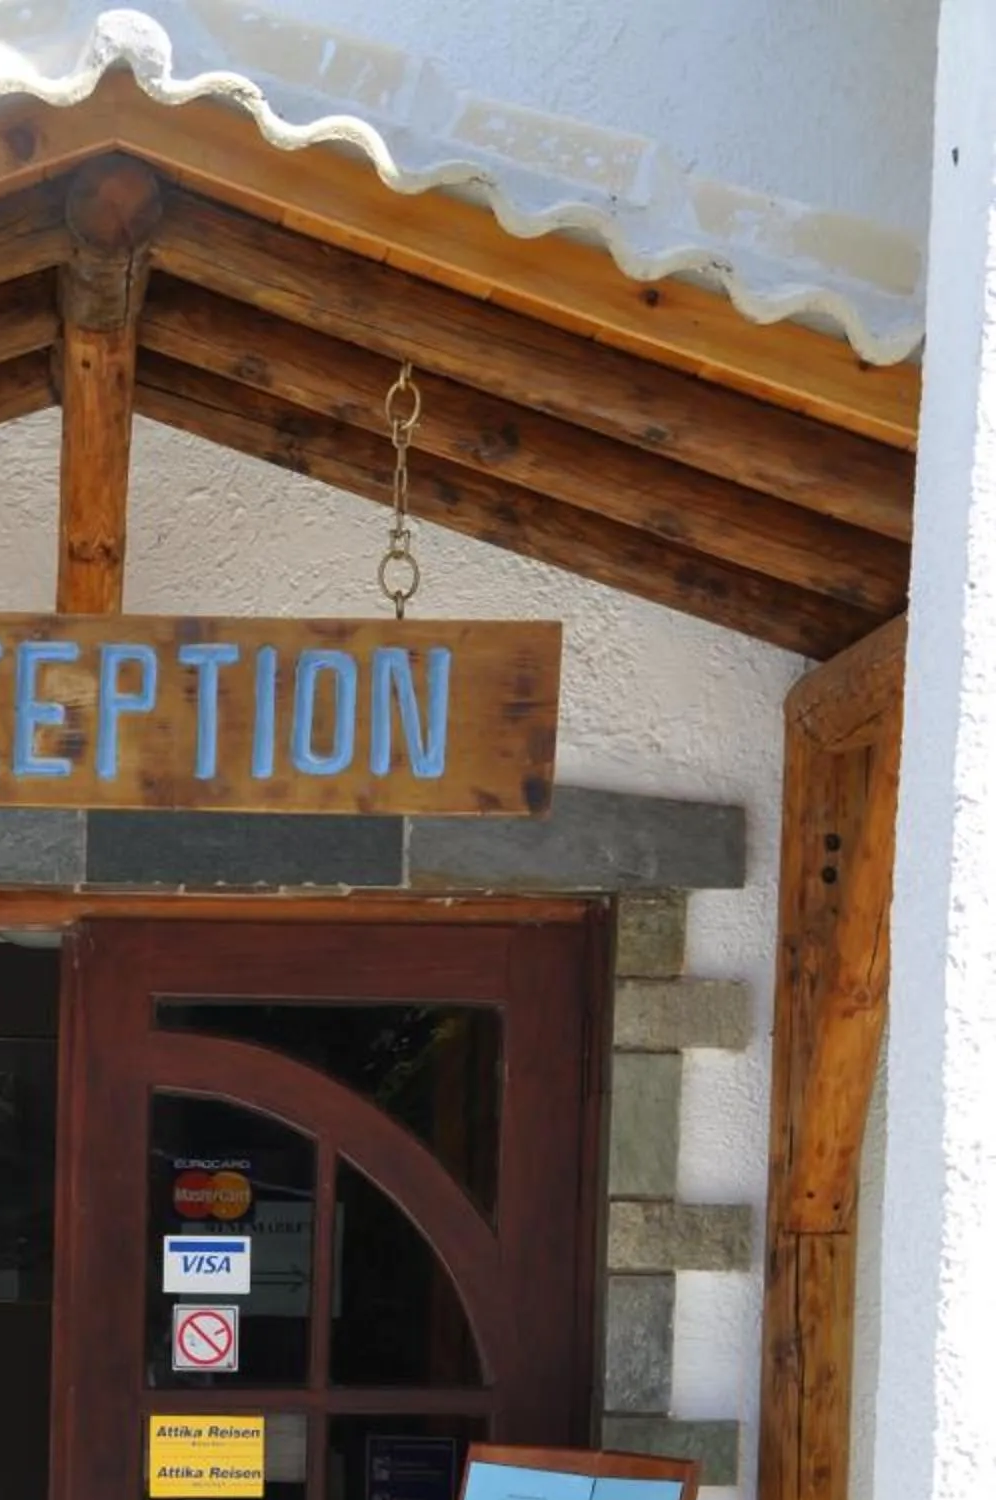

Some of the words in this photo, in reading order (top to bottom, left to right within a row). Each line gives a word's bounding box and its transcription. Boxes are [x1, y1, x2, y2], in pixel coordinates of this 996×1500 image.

[174, 1158, 251, 1169] EUROCARD
[182, 1255, 231, 1274] VISA
[156, 1426, 203, 1438] Attika
[207, 1426, 261, 1439] Reisen
[157, 1466, 204, 1479] Attika
[208, 1466, 262, 1479] Reisen
